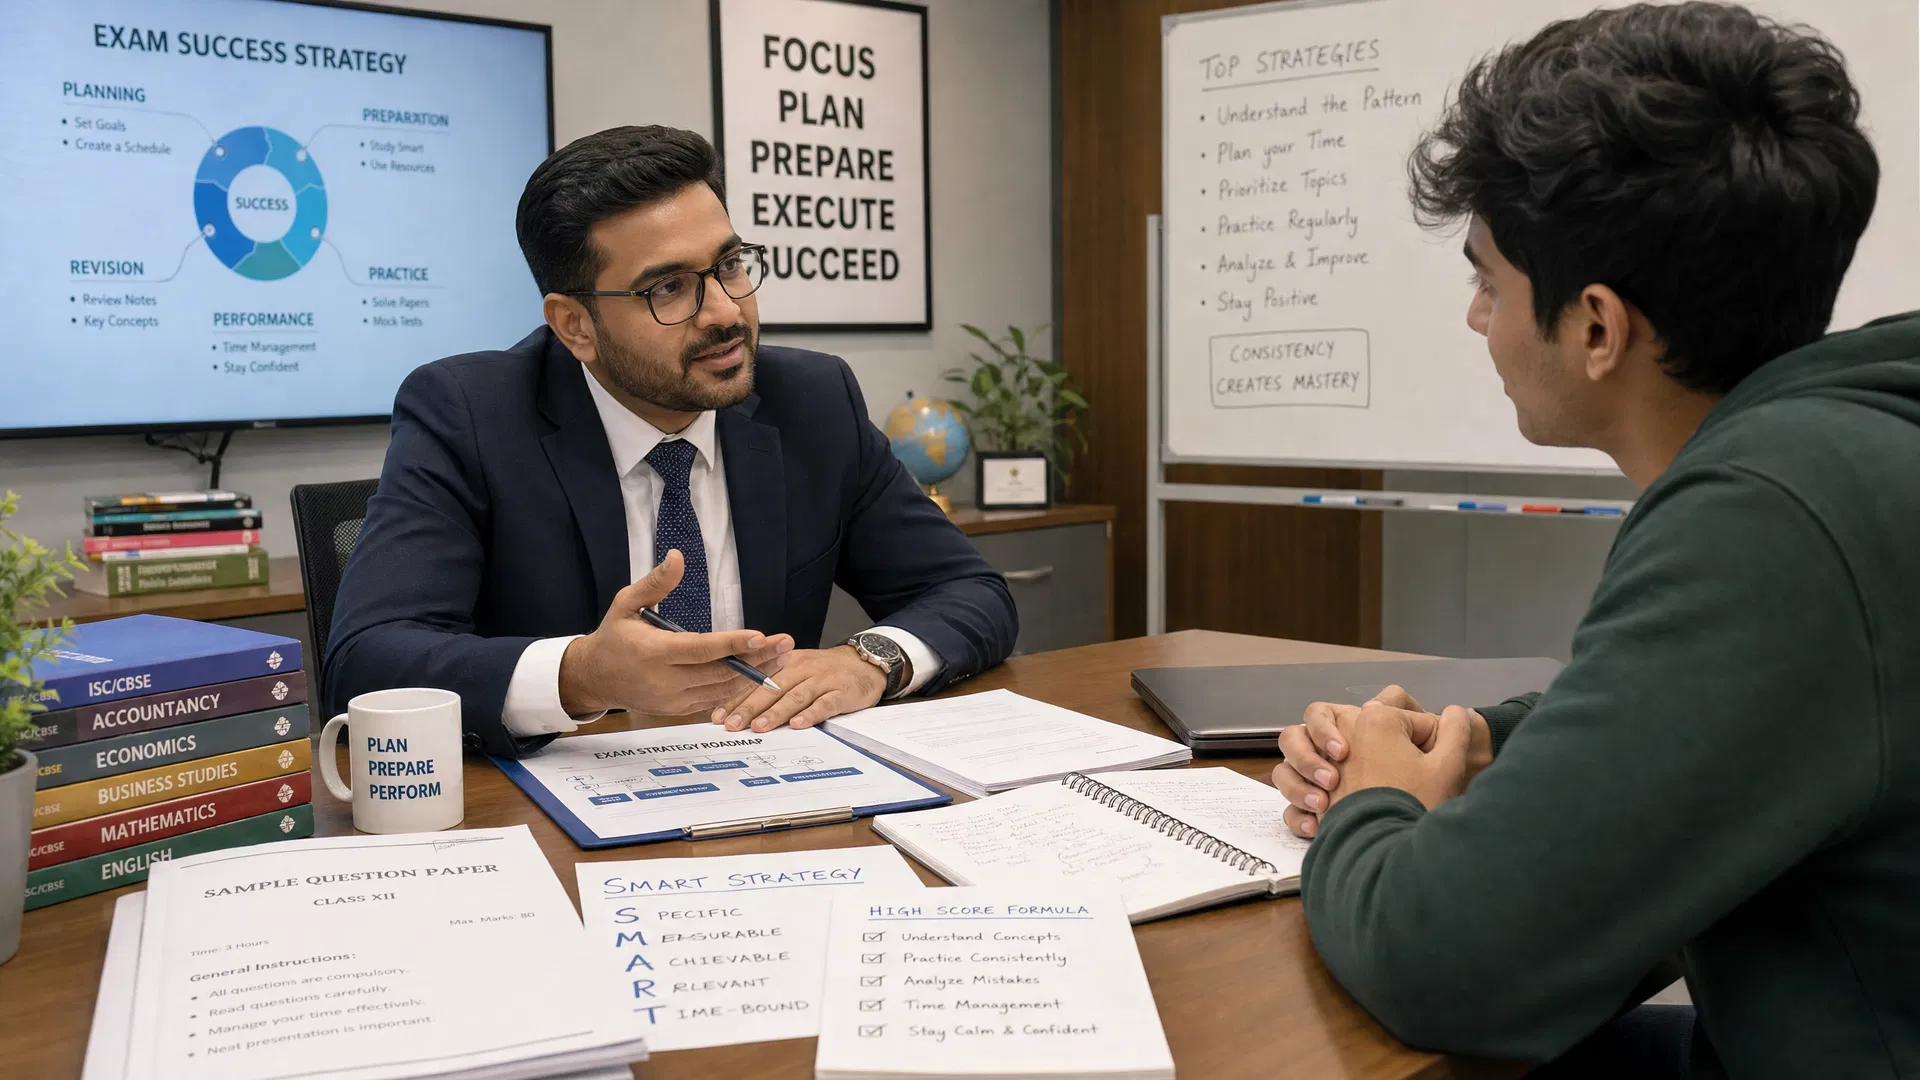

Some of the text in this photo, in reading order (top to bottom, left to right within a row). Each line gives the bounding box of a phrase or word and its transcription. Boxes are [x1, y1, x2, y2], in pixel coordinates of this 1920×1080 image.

[94, 24, 406, 74] EXAM SUCCESS STRATEGY
[764, 34, 876, 79] FOCUS
[1200, 38, 1380, 80] TOP STRATEGIES
[63, 82, 145, 103] PLANNING
[779, 90, 864, 130] PLAN
[1218, 85, 1421, 125] Understand the Pattern
[74, 116, 126, 132] Set Goals
[363, 108, 449, 126] PREPARATION
[76, 138, 170, 155] Create a Schedule
[370, 140, 424, 154] Study Smart
[1218, 129, 1346, 169] Plan your Time
[390, 160, 435, 173] Resources
[751, 140, 894, 181] PREPARE
[1218, 169, 1347, 200] Prioritize Topics
[236, 197, 288, 210] SUCCESS
[752, 193, 895, 230] EXECUTE
[1218, 208, 1358, 240] Practice Regularly
[70, 260, 144, 275] REVISION
[369, 267, 428, 280] PRACTICE
[1216, 247, 1369, 283] Analyze & Improve
[83, 294, 156, 306] Review Notes
[1217, 286, 1318, 322] Stay Positive
[84, 314, 158, 329] Key Concepts
[214, 312, 314, 326] PERFORMANCE
[224, 342, 316, 355] Time Management
[1230, 340, 1335, 363] CONSISTENCY
[224, 361, 298, 374] Stay Confident
[1216, 371, 1359, 395] CREATES MASTERY
[88, 674, 152, 697] ISC/CBSE
[92, 693, 220, 730] ACCOUNTANCY
[96, 735, 196, 769] ECONOMICS
[368, 737, 408, 753] PLAN
[594, 738, 763, 760] EXAM STRATEGY ROADMAP
[369, 759, 434, 776] PREPARE
[98, 762, 238, 805] BUSINESS STUDIES
[370, 782, 441, 800] PERFORM
[101, 802, 216, 844] MATHEMATICS
[102, 848, 172, 881] ENGLISH
[204, 864, 500, 899] SAMPLE QUESTION PAPER
[604, 867, 862, 895] SMART STRATEGY
[314, 892, 396, 907] CLASS XII
[870, 904, 1089, 916] HIGH SCORE FORMULA
[481, 914, 517, 922] Marks:
[614, 907, 743, 924] S PECIFIC
[616, 931, 648, 948] M
[902, 931, 1060, 943] Understand Concepts
[190, 948, 222, 957] Time:
[235, 939, 270, 949] Hours
[190, 952, 356, 982] General Instructions:
[625, 952, 790, 972] A CHIEVABLE
[904, 952, 1067, 968] Practice Consistently
[209, 968, 410, 998] All questions are compulsory.
[633, 980, 656, 998] R
[904, 975, 1040, 990] Analyze Mistakes
[209, 985, 392, 1017] Read questions carefully.
[905, 999, 1063, 1015] Time Management
[208, 1000, 426, 1036] Manage your time effectively.
[633, 1001, 809, 1025] T IME-BOUND
[207, 1042, 241, 1056] Neat
[246, 1028, 339, 1049] presentation
[359, 1016, 436, 1032] important.
[908, 1024, 1099, 1042] Stay Calm & Confident
